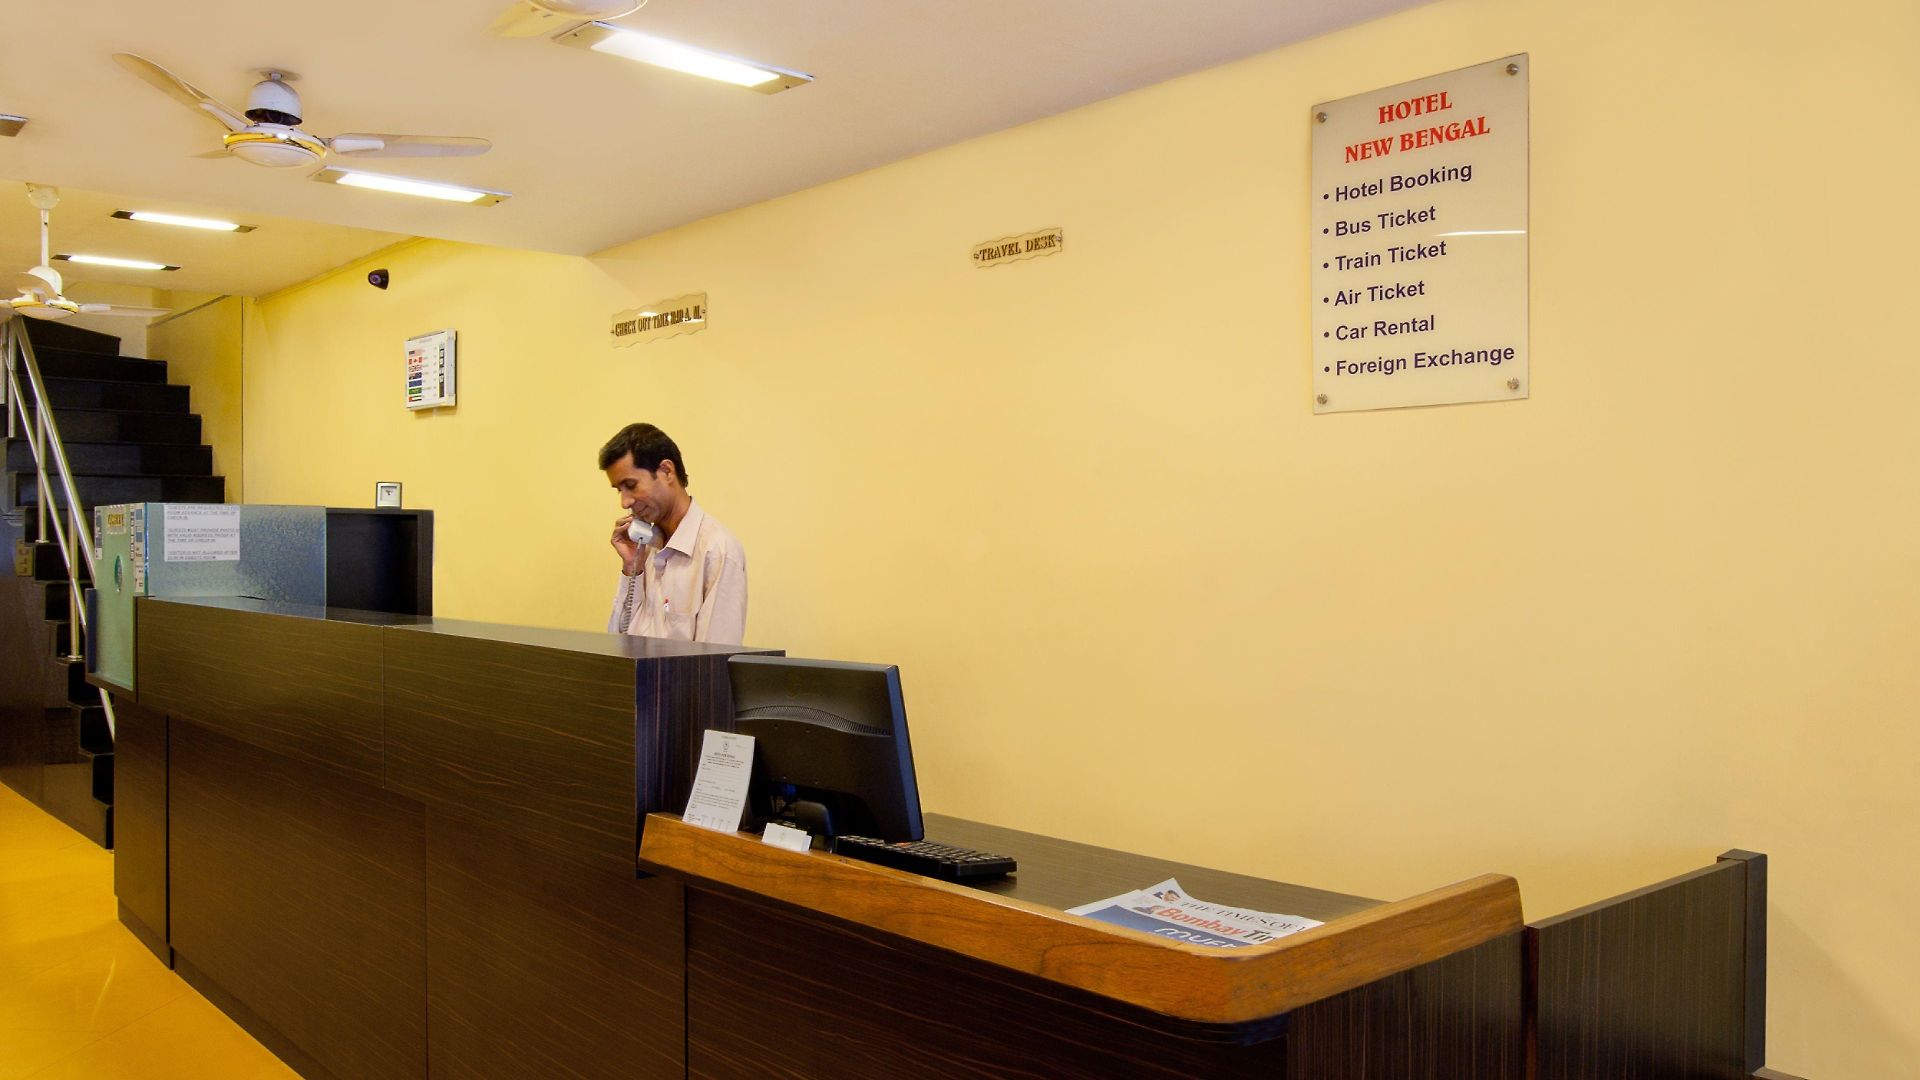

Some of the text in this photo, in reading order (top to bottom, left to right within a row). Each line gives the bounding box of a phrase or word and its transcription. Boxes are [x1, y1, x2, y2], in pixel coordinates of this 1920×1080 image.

[1378, 91, 1453, 124] HOTEL
[1345, 116, 1491, 164] NEW BENGAL
[1335, 164, 1473, 202] Hotel Booking
[1335, 205, 1437, 237] Bus Ticket
[979, 234, 1056, 261] TRAVEL DESK
[1335, 240, 1447, 271] Train Ticket
[1334, 280, 1426, 307] Air Ticket
[638, 316, 652, 332] OUT
[1335, 314, 1435, 341] Car Rental
[1336, 347, 1515, 376] Foreign Exchange
[1156, 907, 1248, 935] Bombay
